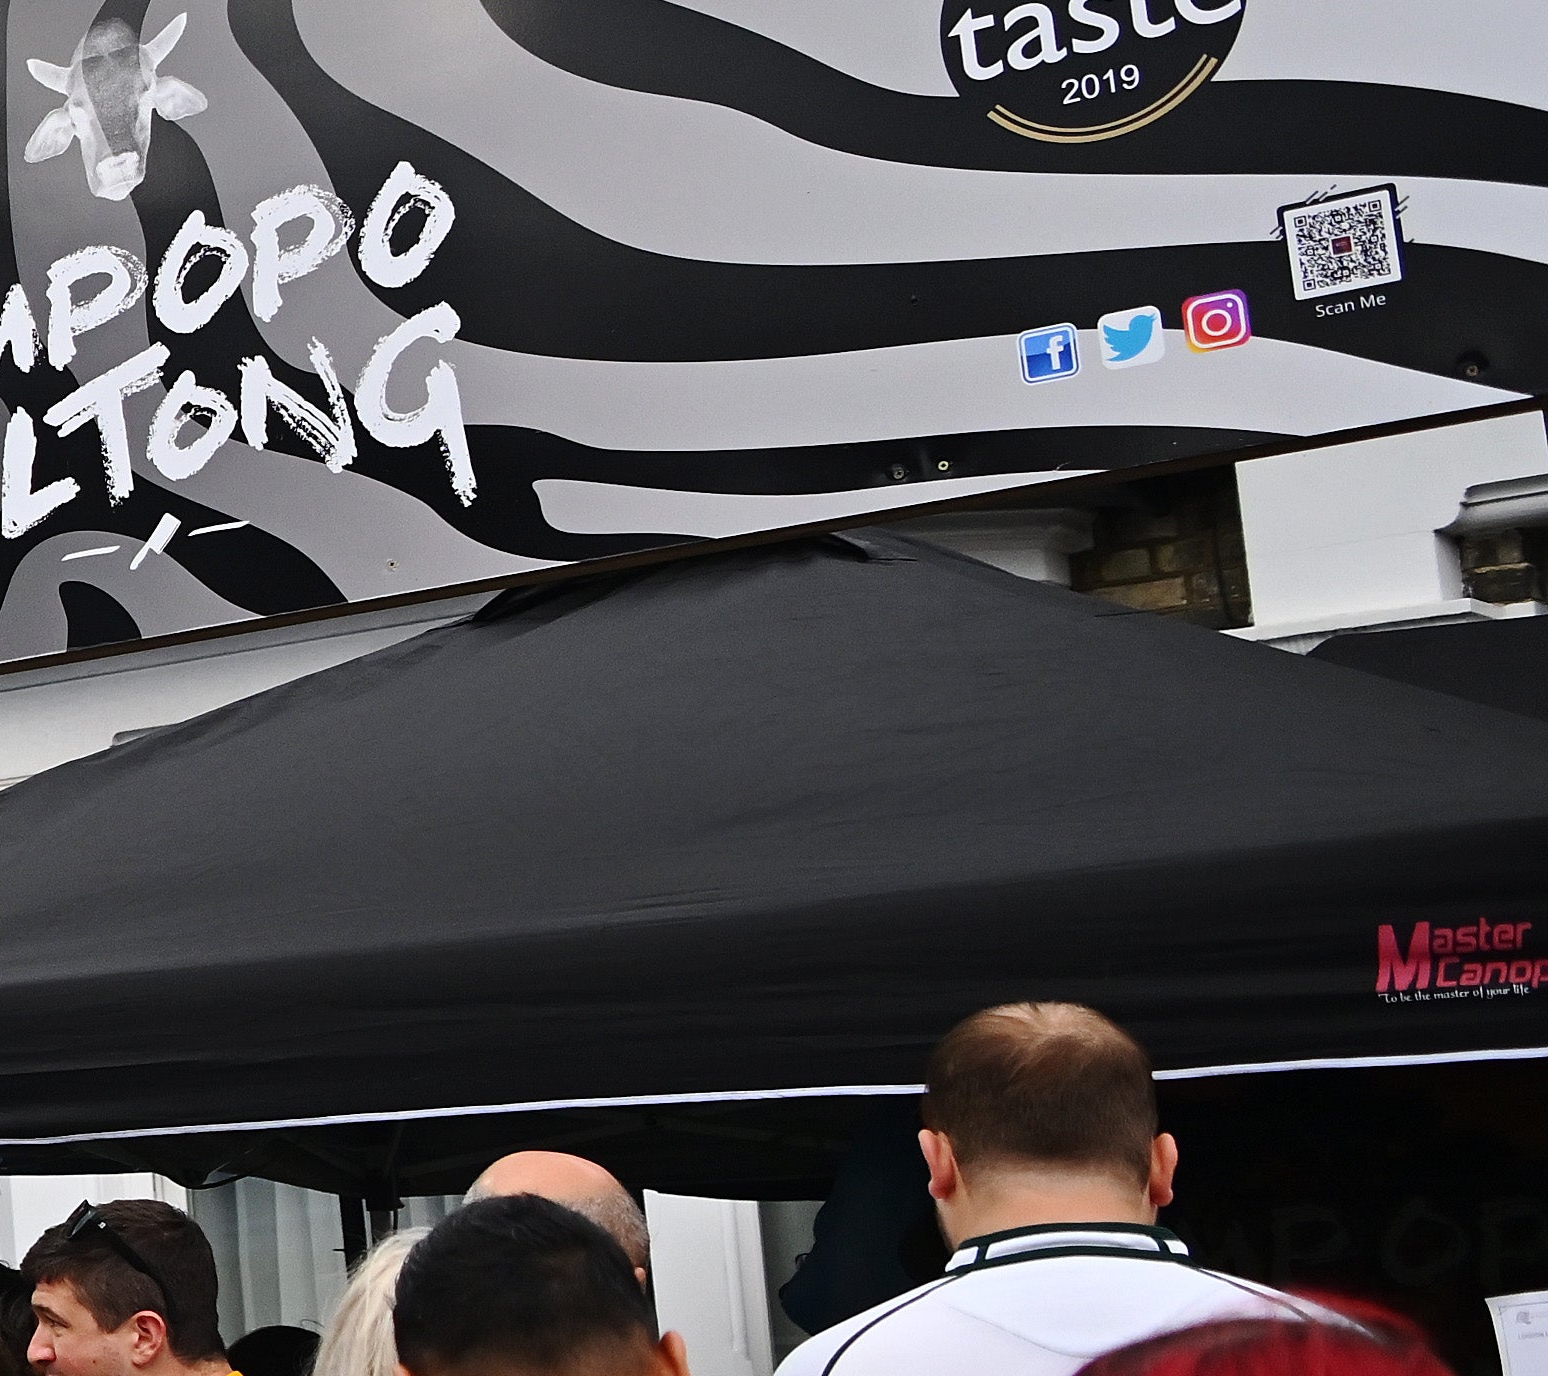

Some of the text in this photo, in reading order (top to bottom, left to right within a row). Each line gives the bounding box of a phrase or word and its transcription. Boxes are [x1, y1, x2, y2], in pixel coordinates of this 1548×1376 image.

[1060, 64, 1141, 105] 2019
[1315, 294, 1386, 318] Scan Me
[1375, 916, 1532, 992] Master
[1378, 993, 1398, 1004] To
[1400, 992, 1412, 1002] be
[1415, 990, 1431, 1001] the
[1433, 990, 1469, 1000] master
[1486, 987, 1510, 1000] your
[1513, 984, 1531, 996] life
